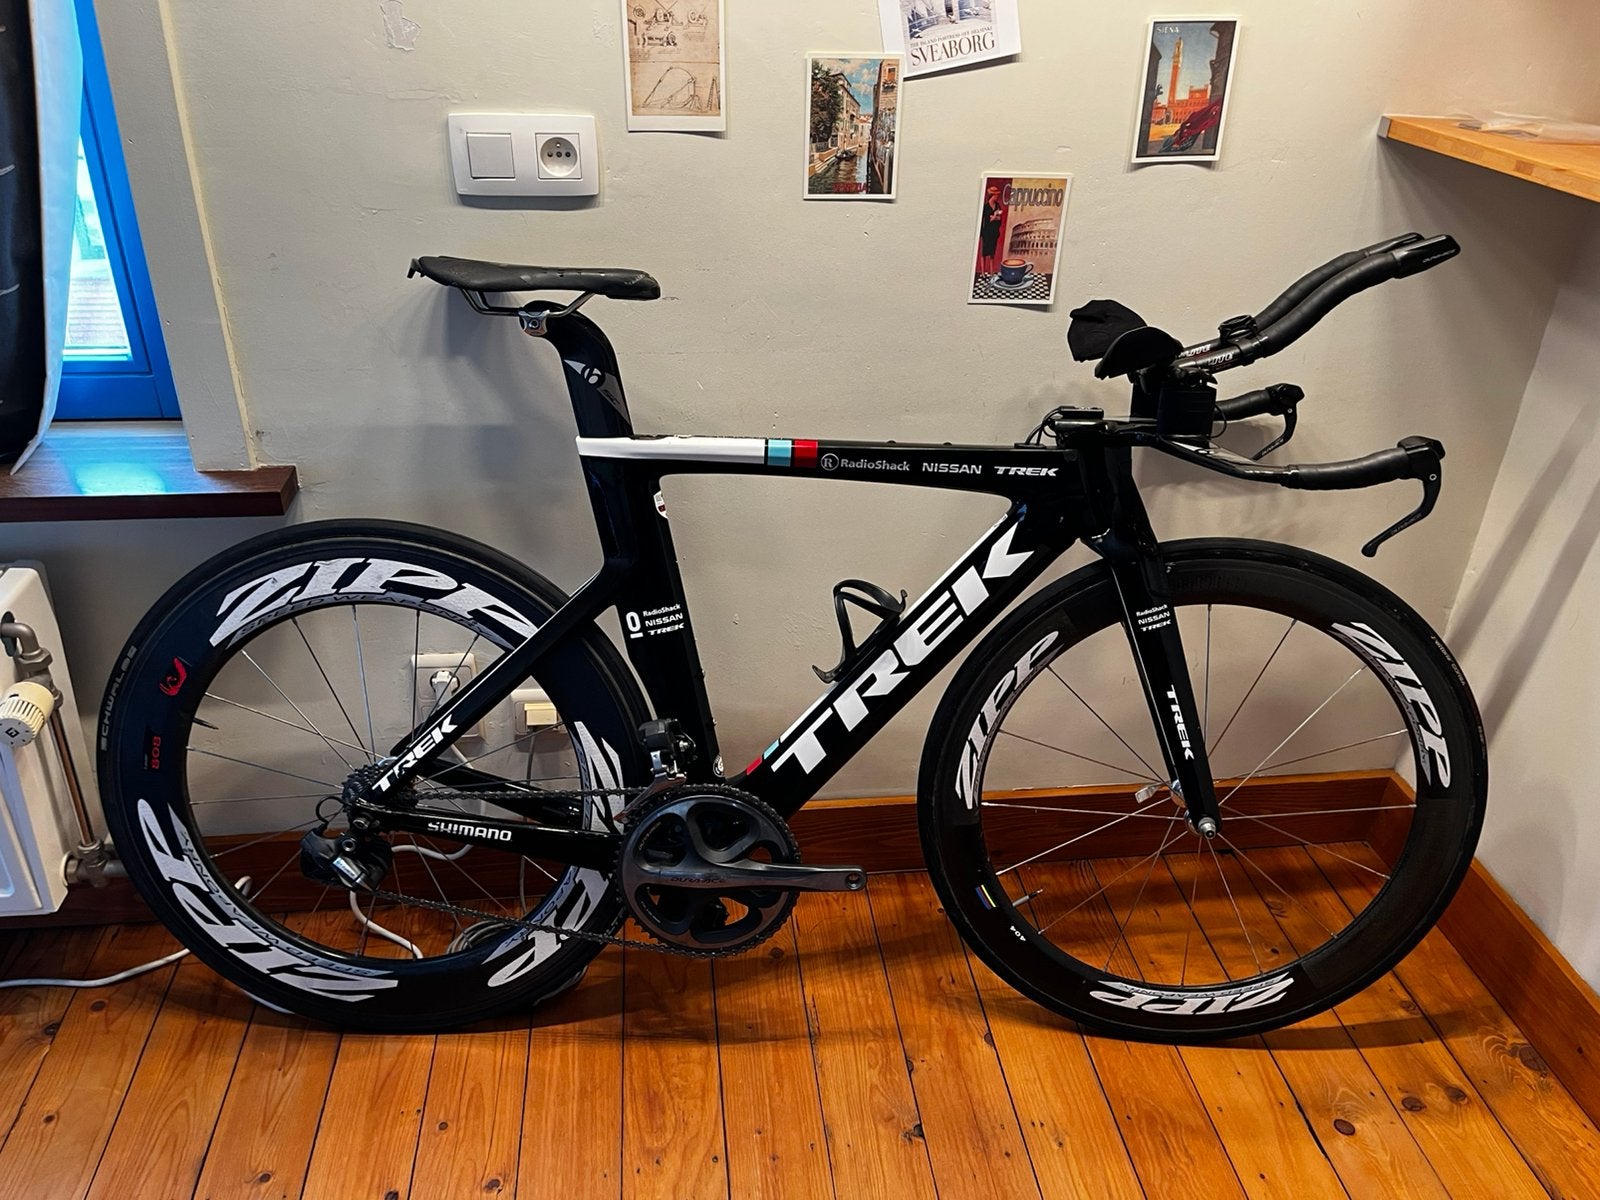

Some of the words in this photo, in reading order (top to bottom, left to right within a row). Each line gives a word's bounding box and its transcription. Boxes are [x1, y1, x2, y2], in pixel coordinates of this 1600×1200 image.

[1156, 26, 1180, 34] SIENA
[911, 31, 995, 66] SVEABORG
[1003, 183, 1063, 212] Cappuccino
[840, 458, 910, 471] RadioShack
[922, 462, 982, 475] NISSAN
[994, 466, 1059, 476] TREK
[643, 603, 681, 617] RadioShack
[645, 612, 683, 627] NISSAN
[1136, 604, 1168, 617] RadioShack
[1138, 611, 1170, 625] NISSAN
[648, 622, 684, 635] TREK
[1141, 619, 1171, 632] TREK
[771, 522, 1034, 774] TREK
[1331, 622, 1451, 788] ZIPP
[955, 631, 1059, 810] ZIPP
[1166, 684, 1195, 760] TREK
[372, 714, 458, 792] TREK
[427, 821, 512, 842] SHIMANO
[137, 799, 398, 1002] ZIPP
[1089, 978, 1294, 1015] ZIPP
